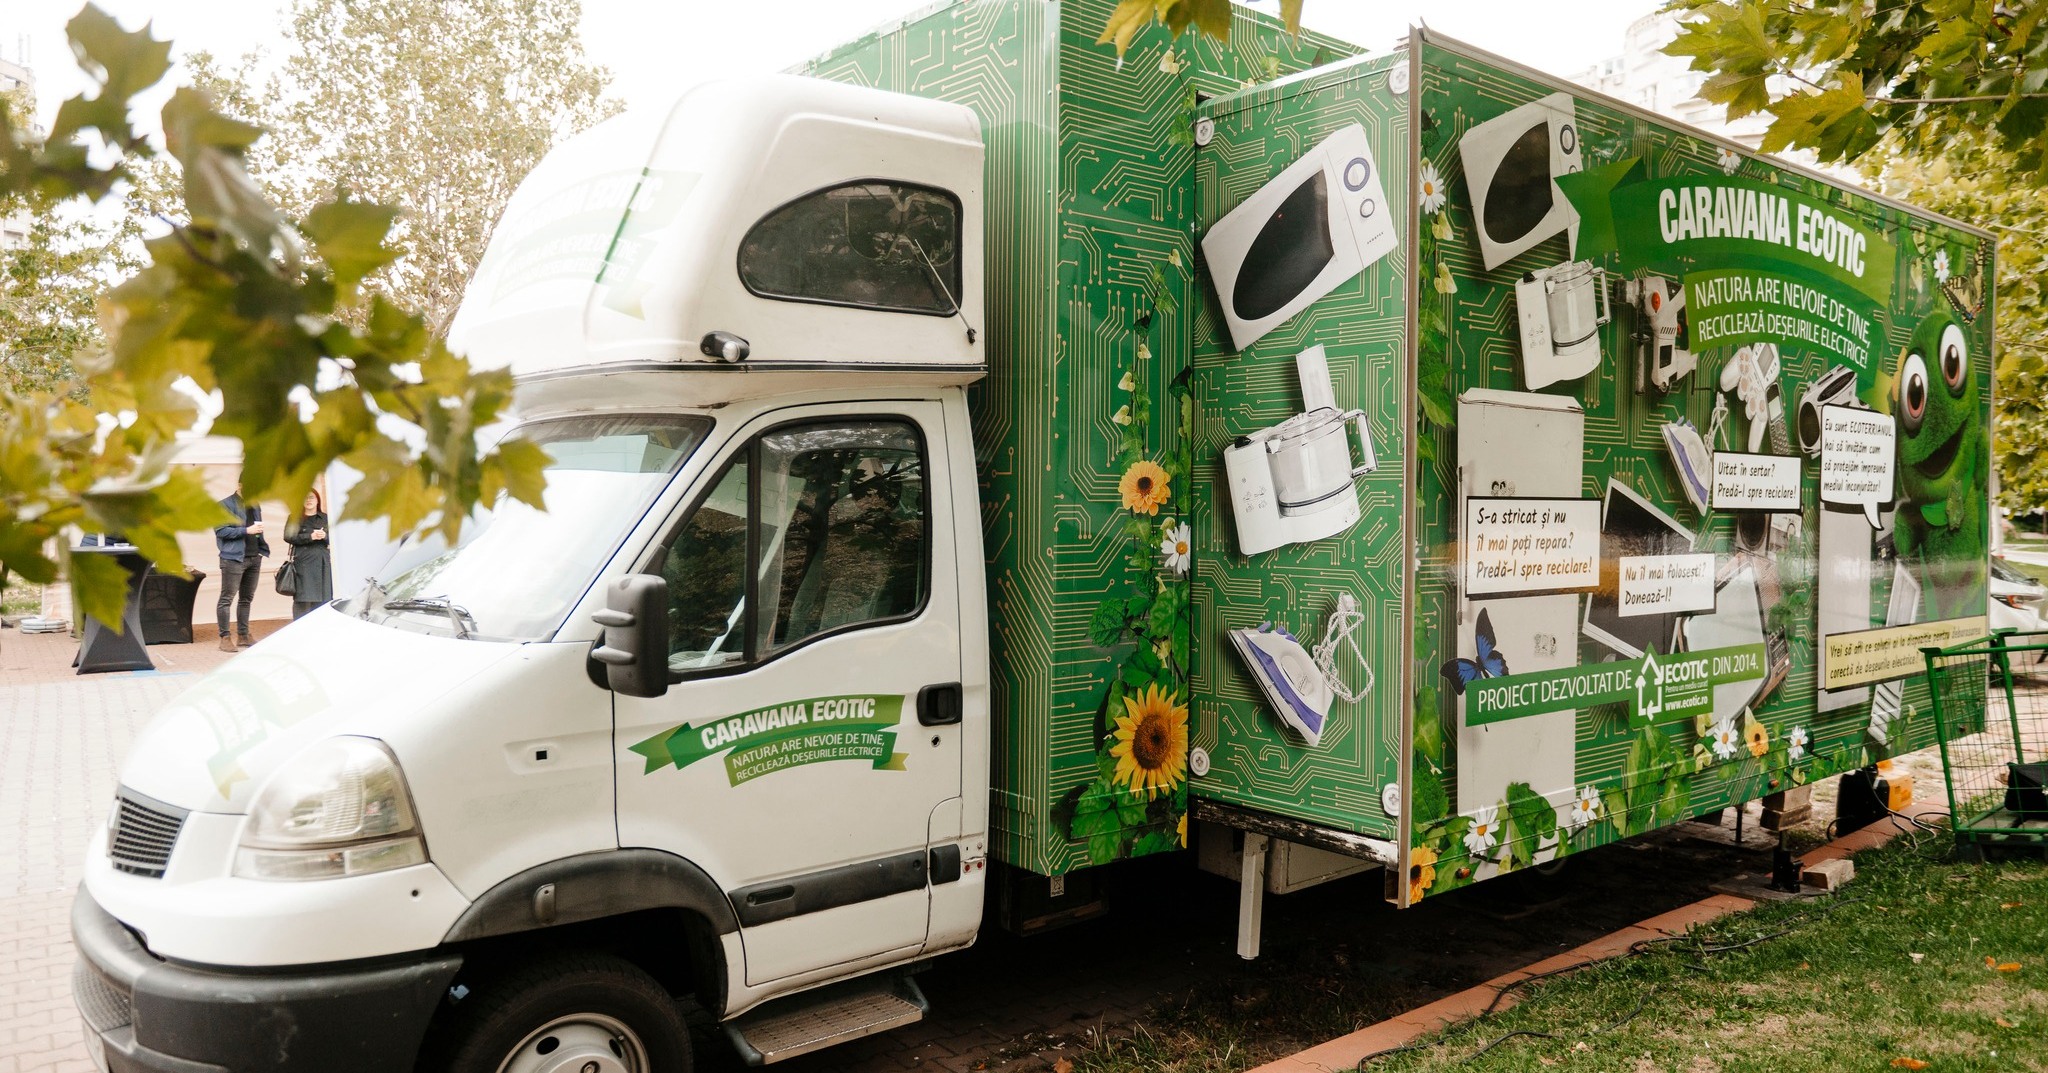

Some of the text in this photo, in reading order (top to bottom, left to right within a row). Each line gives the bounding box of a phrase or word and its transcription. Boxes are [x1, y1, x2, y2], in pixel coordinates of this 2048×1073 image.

[1659, 186, 1866, 278] CARAVANA ECOTIC
[1695, 276, 1870, 348] NATURA ARE NEVOIE DE TINE,
[1698, 309, 1766, 342] RECICLEAZĂ
[1820, 326, 1868, 369] ELECTRICE!
[1825, 418, 1832, 431] Eu
[1835, 421, 1847, 432] sunt
[1825, 437, 1834, 451] hai
[1836, 440, 1843, 452] să
[1869, 446, 1880, 454] cum
[1718, 461, 1776, 478] Uitat în sertar?
[1824, 459, 1831, 471] să
[1833, 460, 1859, 476] protejăm
[1718, 483, 1797, 501] Predă-l spre reciclare!
[1823, 478, 1843, 491] mediul
[1477, 507, 1567, 530] S-a stricat și nu
[1477, 531, 1574, 556] îl mai poți repara?
[1476, 556, 1593, 583] Predă-l spre reciclare!
[1625, 560, 1707, 584] Nu îl mai folosești?
[1625, 589, 1672, 606] Donează-l!
[1830, 644, 1843, 658] Vrei
[1844, 643, 1852, 656] să
[1865, 643, 1872, 653] ce
[1830, 662, 1854, 679] corectă
[1856, 661, 1862, 675] de
[1478, 652, 1759, 713] PROIECT DEZVOLTAT DE ECOTIC DIN 2014.
[1665, 695, 1708, 711] www.ecotic.ro
[701, 698, 875, 750] CARAVANA ECOTIC
[732, 733, 885, 769] NATURA ARE NEVOIE DE TINE,
[736, 754, 790, 782] RECICLEAZĂ
[839, 747, 883, 757] ELECTRICE!
